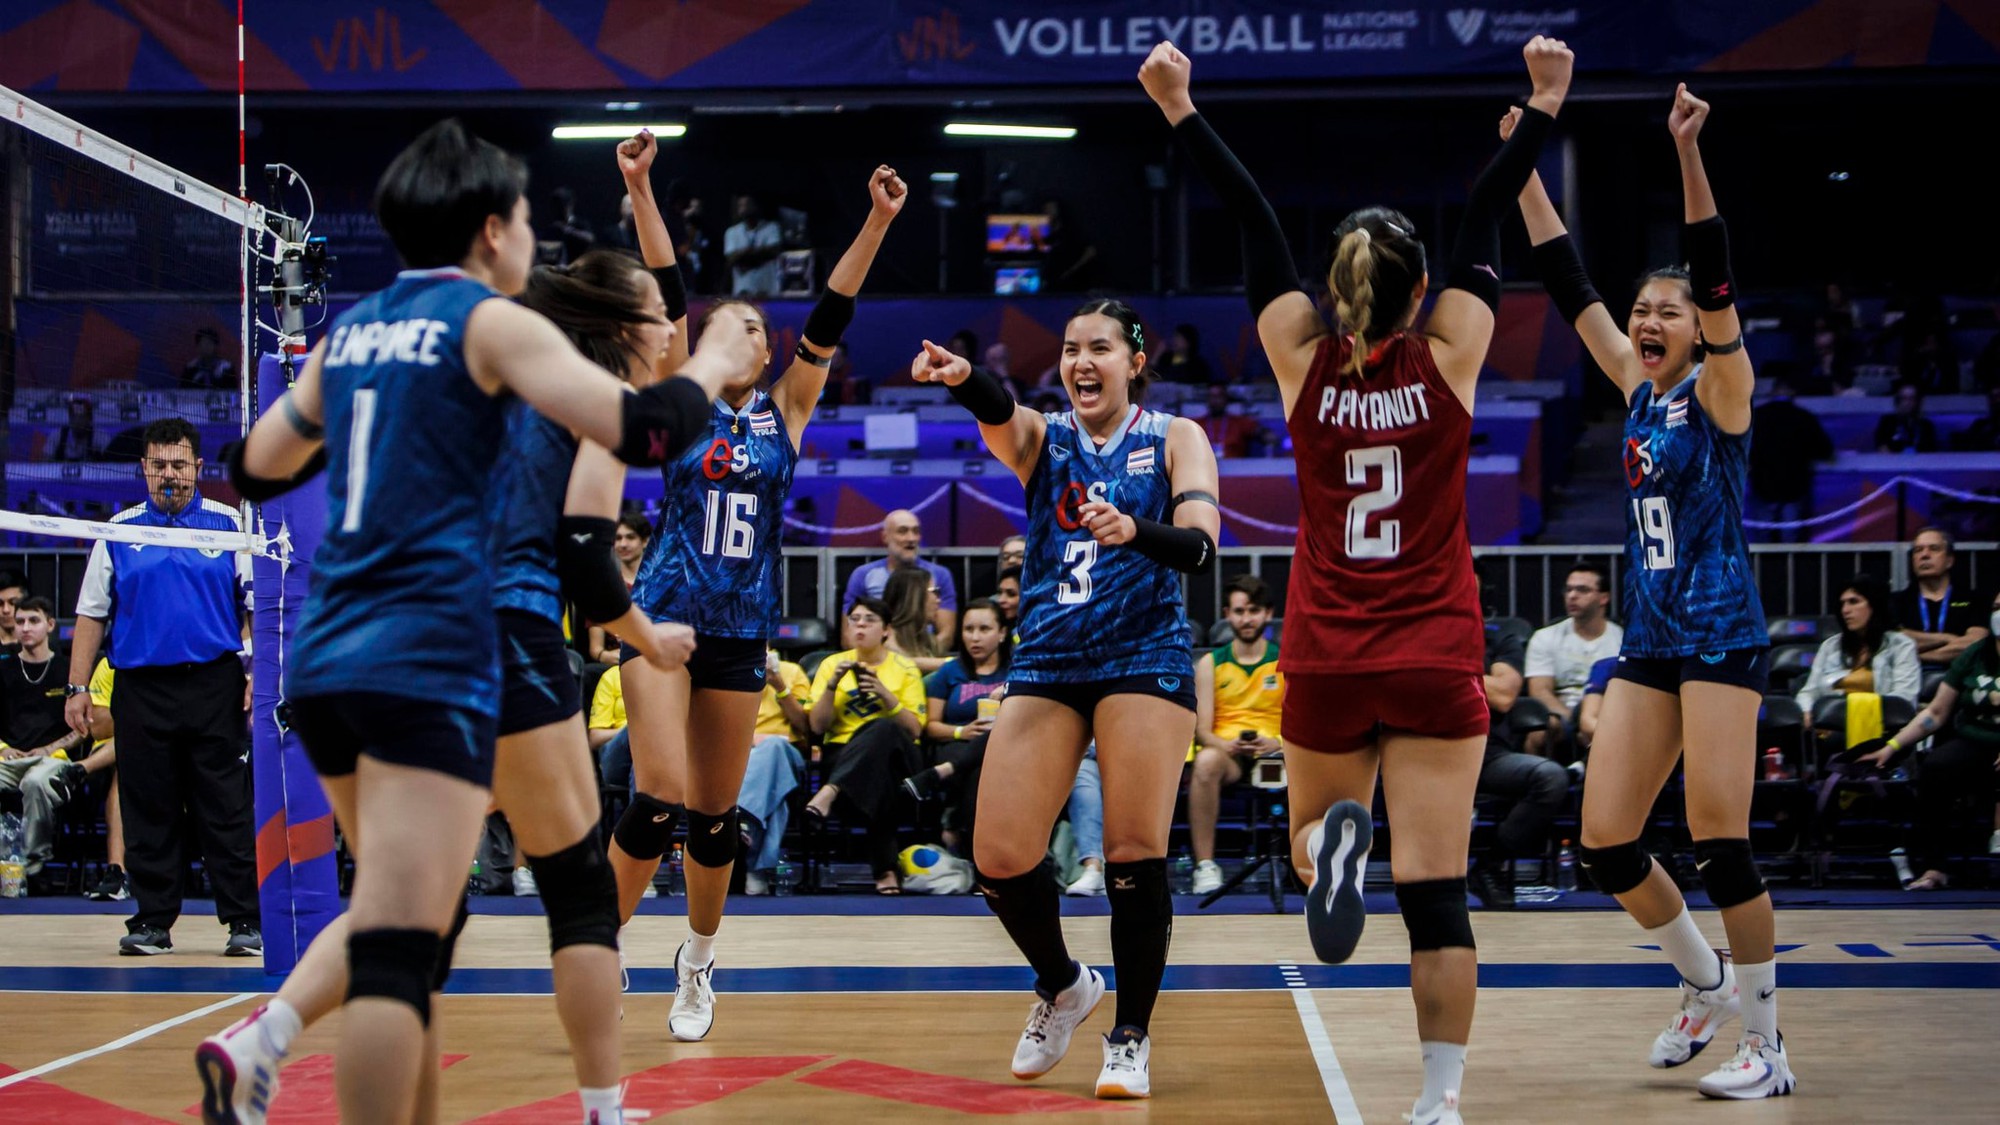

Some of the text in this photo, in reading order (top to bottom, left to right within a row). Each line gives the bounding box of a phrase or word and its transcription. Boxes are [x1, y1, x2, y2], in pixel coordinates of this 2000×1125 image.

[994, 16, 1314, 55] VOLLEYBALL
[1322, 10, 1418, 29] NATIONS
[1322, 31, 1406, 50] LEAGUE
[1317, 382, 1430, 431] P.PIYANUT
[752, 427, 778, 436] THA
[342, 388, 378, 532] 1
[702, 436, 760, 480] est
[702, 490, 758, 559] 16
[1344, 445, 1403, 559] 2
[1632, 496, 1676, 570] 19
[1058, 540, 1098, 604] 3
